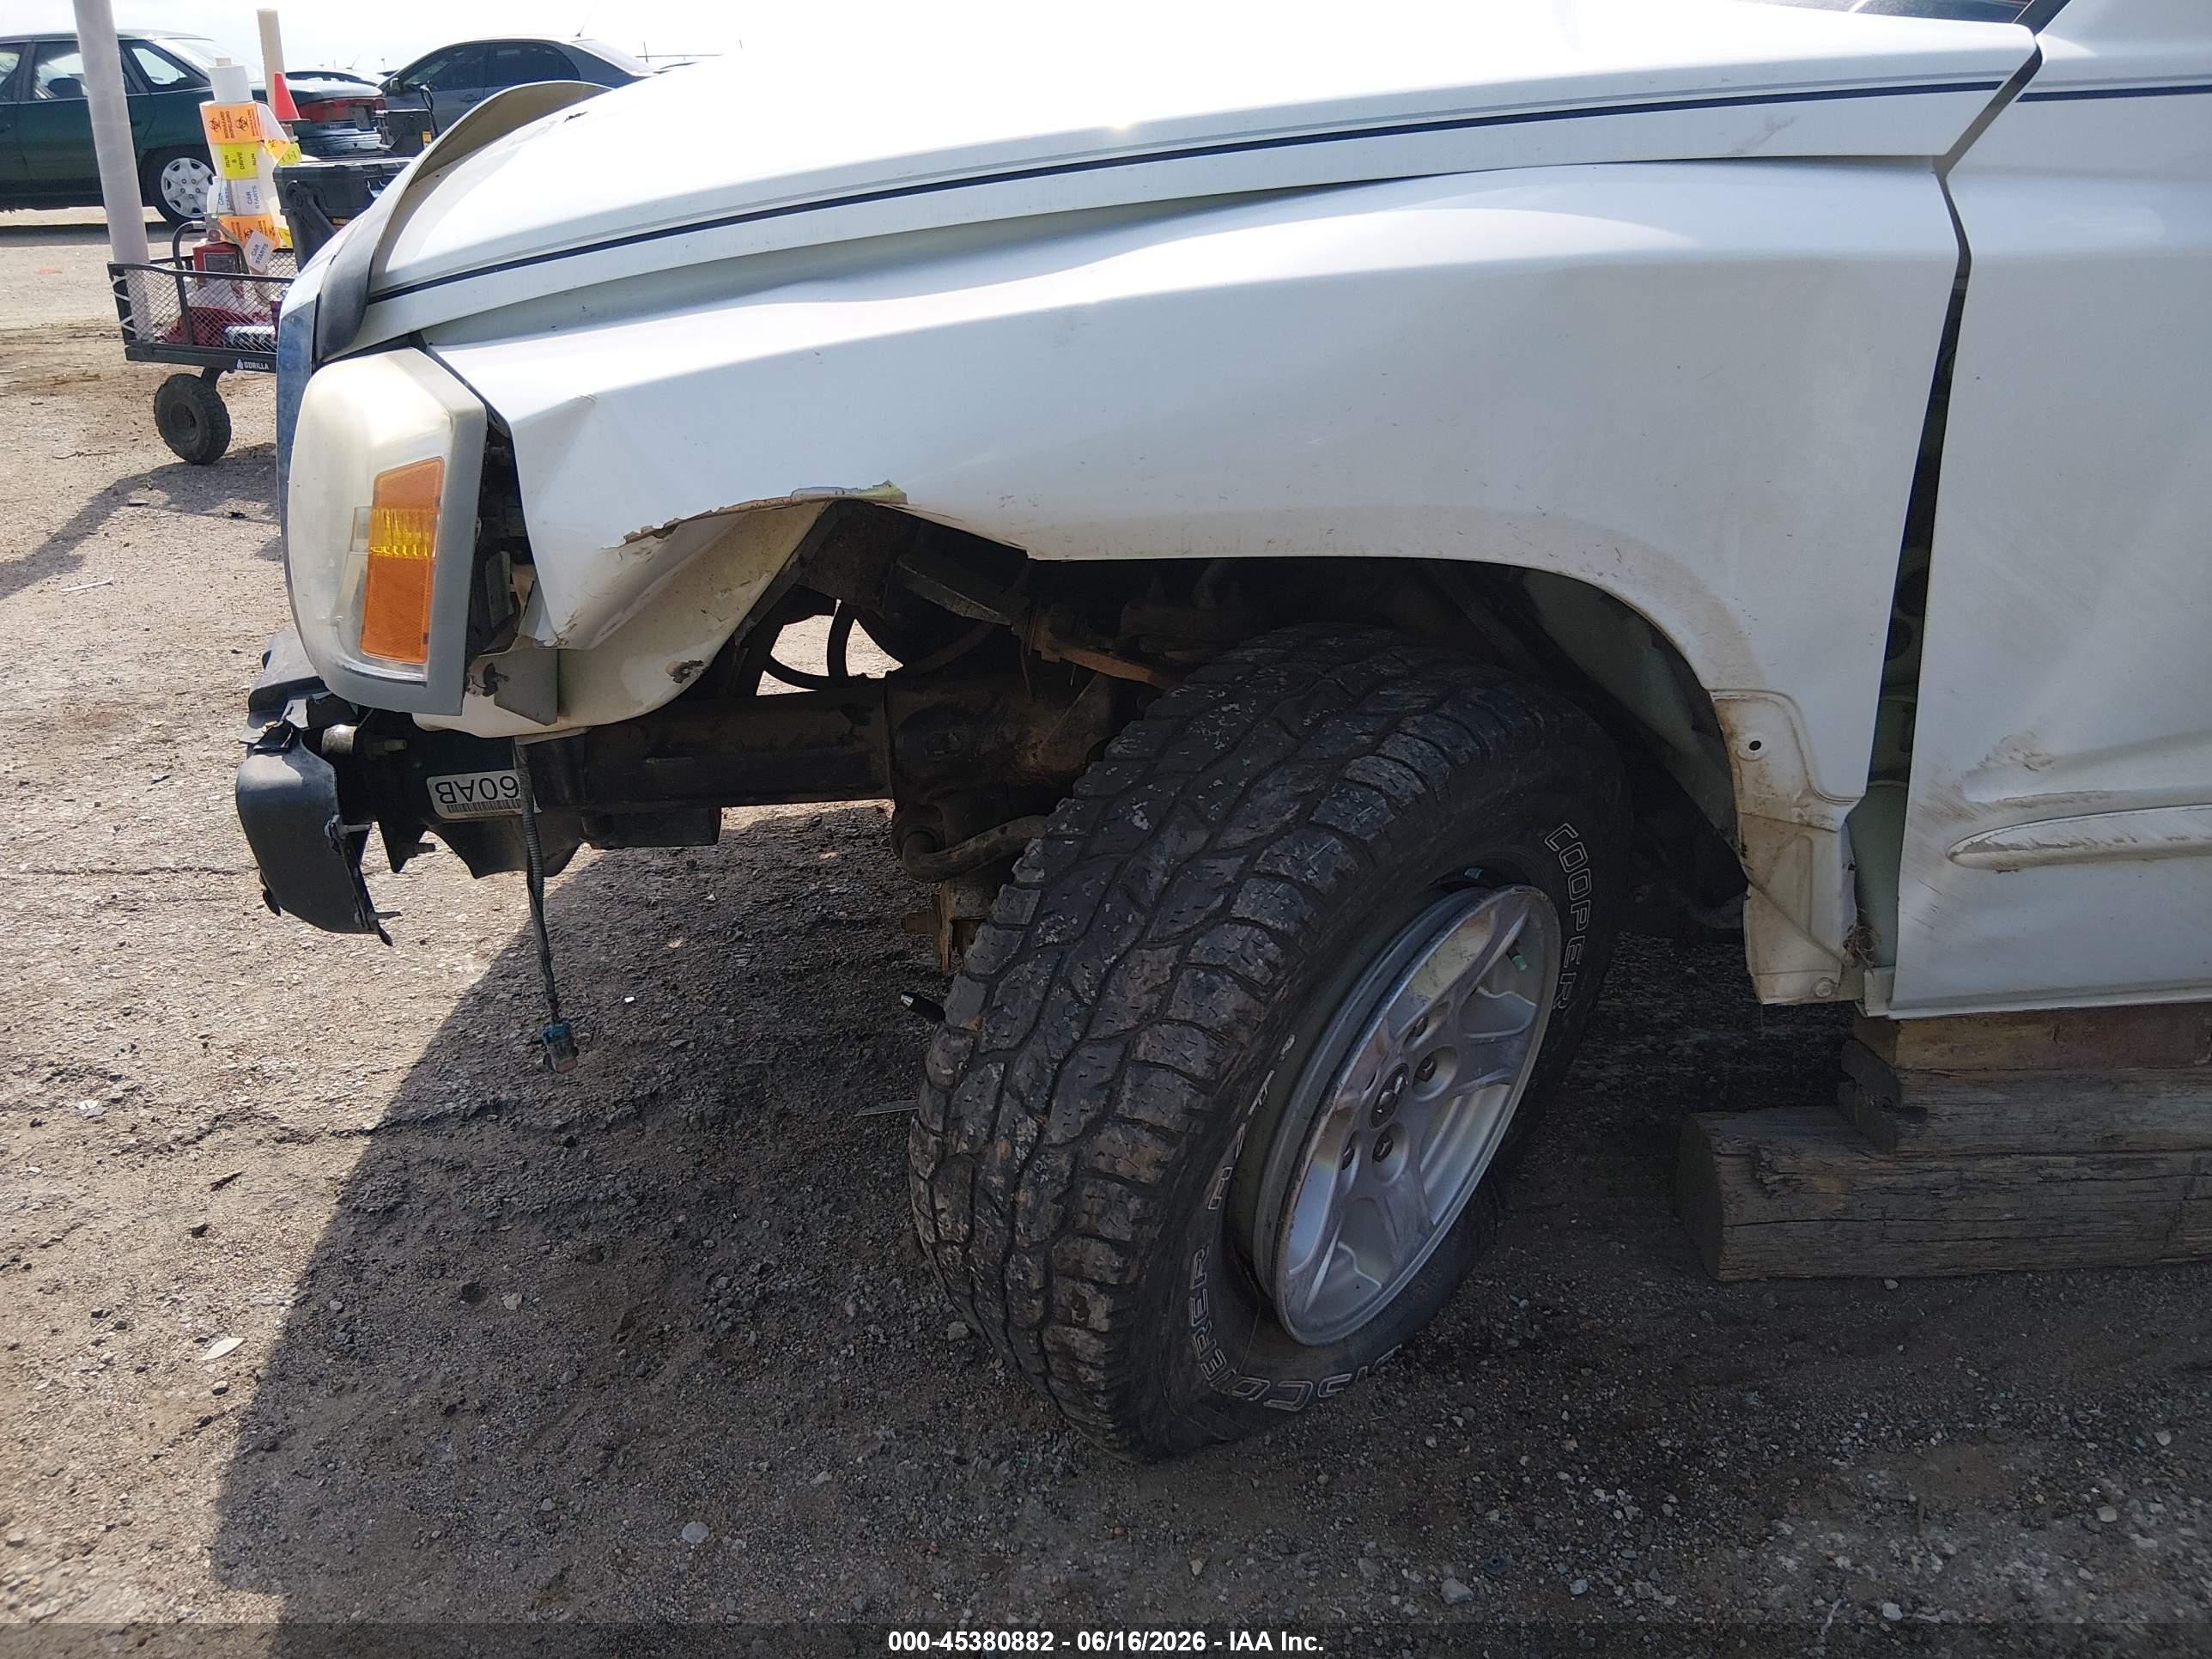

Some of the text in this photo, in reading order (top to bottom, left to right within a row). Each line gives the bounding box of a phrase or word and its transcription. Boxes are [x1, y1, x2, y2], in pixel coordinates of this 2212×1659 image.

[236, 151, 246, 170] DRIVE
[251, 243, 260, 257] CAR
[255, 243, 269, 264] STARTS
[244, 362, 269, 370] GORILLA
[434, 775, 520, 805] 60AB
[1543, 822, 1594, 1011] COOPER
[1188, 1243, 1405, 1413] SCOVERER
